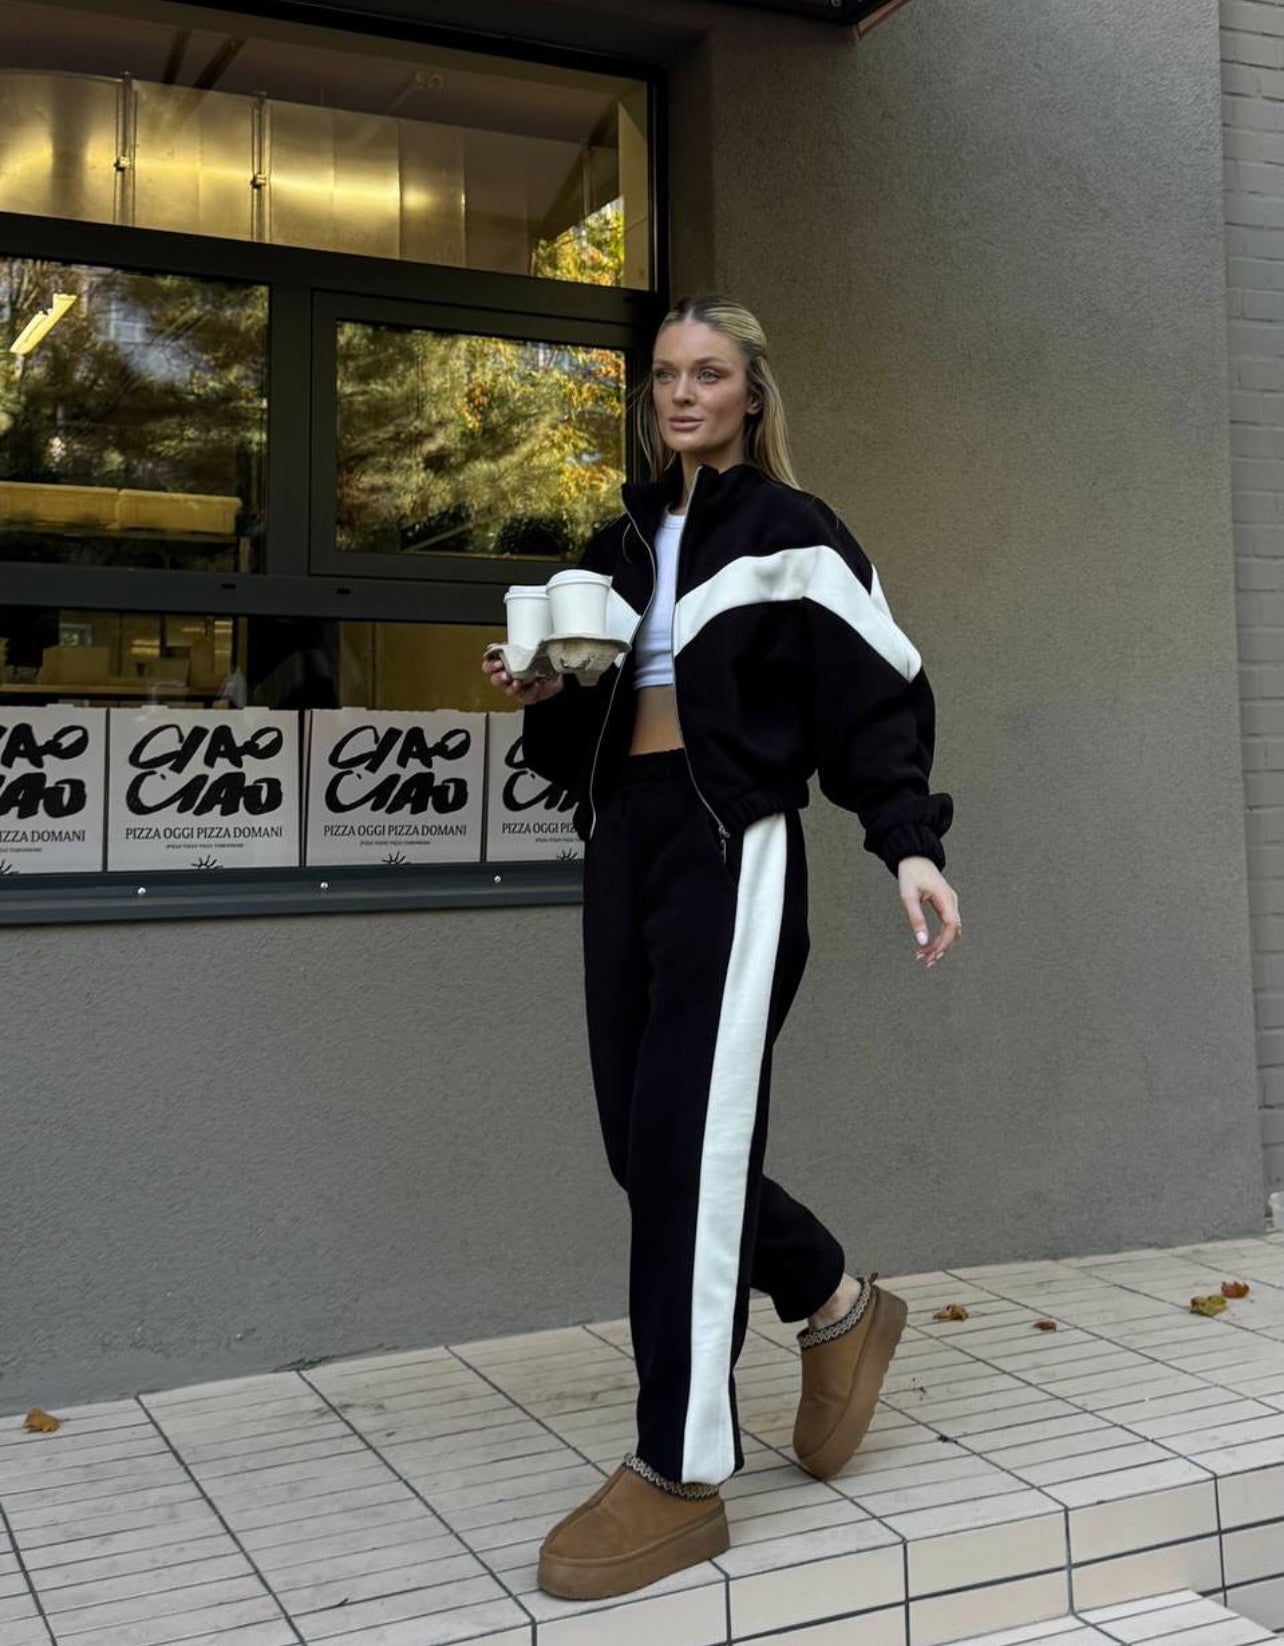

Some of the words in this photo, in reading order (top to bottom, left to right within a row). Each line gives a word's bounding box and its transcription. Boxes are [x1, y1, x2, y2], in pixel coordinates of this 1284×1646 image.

[0, 723, 89, 768] AO
[128, 724, 283, 774] CIAO
[328, 725, 471, 773] CIAO
[0, 772, 87, 819] AO
[126, 770, 283, 816] CIAO
[325, 770, 468, 814] CIAO
[31, 829, 86, 843] DOMANI
[125, 827, 161, 840] PIZZA
[163, 826, 194, 840] OGGI
[196, 826, 231, 839] PIZZA
[233, 825, 283, 839] DOMANI
[323, 824, 355, 837] PIZZA
[357, 824, 385, 837] OGGI
[387, 824, 419, 837] PIZZA
[421, 824, 467, 837] DOMANI
[502, 822, 531, 835] PIZZA
[532, 822, 559, 835] OGGI
